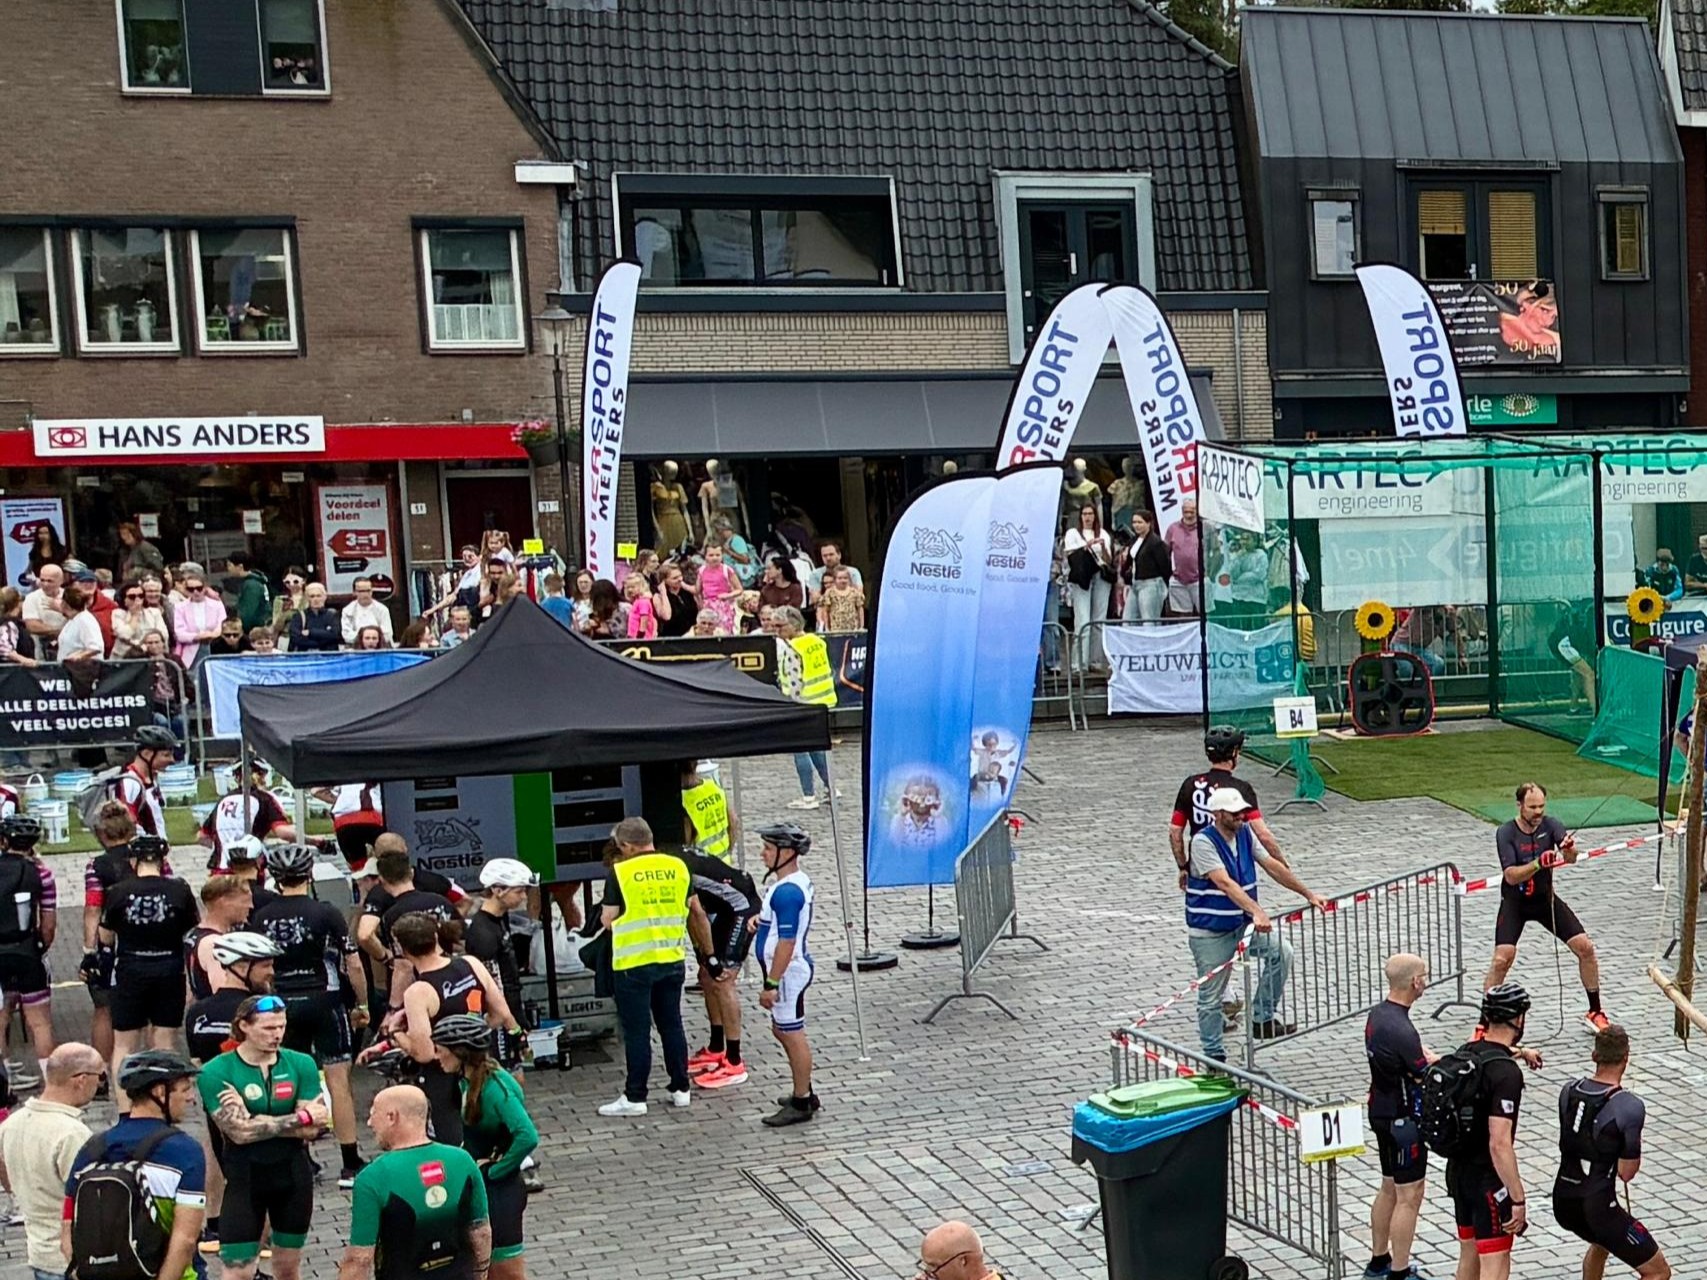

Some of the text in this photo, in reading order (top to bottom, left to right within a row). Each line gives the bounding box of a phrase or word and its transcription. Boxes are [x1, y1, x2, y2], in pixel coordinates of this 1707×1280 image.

[98, 422, 310, 448] HANS ANDERS
[597, 386, 625, 521] MEIJERS
[1600, 479, 1687, 500] ngineering
[1318, 491, 1423, 514] engineering
[1611, 617, 1705, 639] Cofigure
[37, 694, 147, 712] DEELNEMERS
[11, 715, 131, 732] VEEL SUCCES!
[1289, 708, 1303, 729] B4
[633, 868, 677, 883] CREW
[564, 1000, 603, 1013] LIGHTS
[1322, 1110, 1341, 1146] D1
